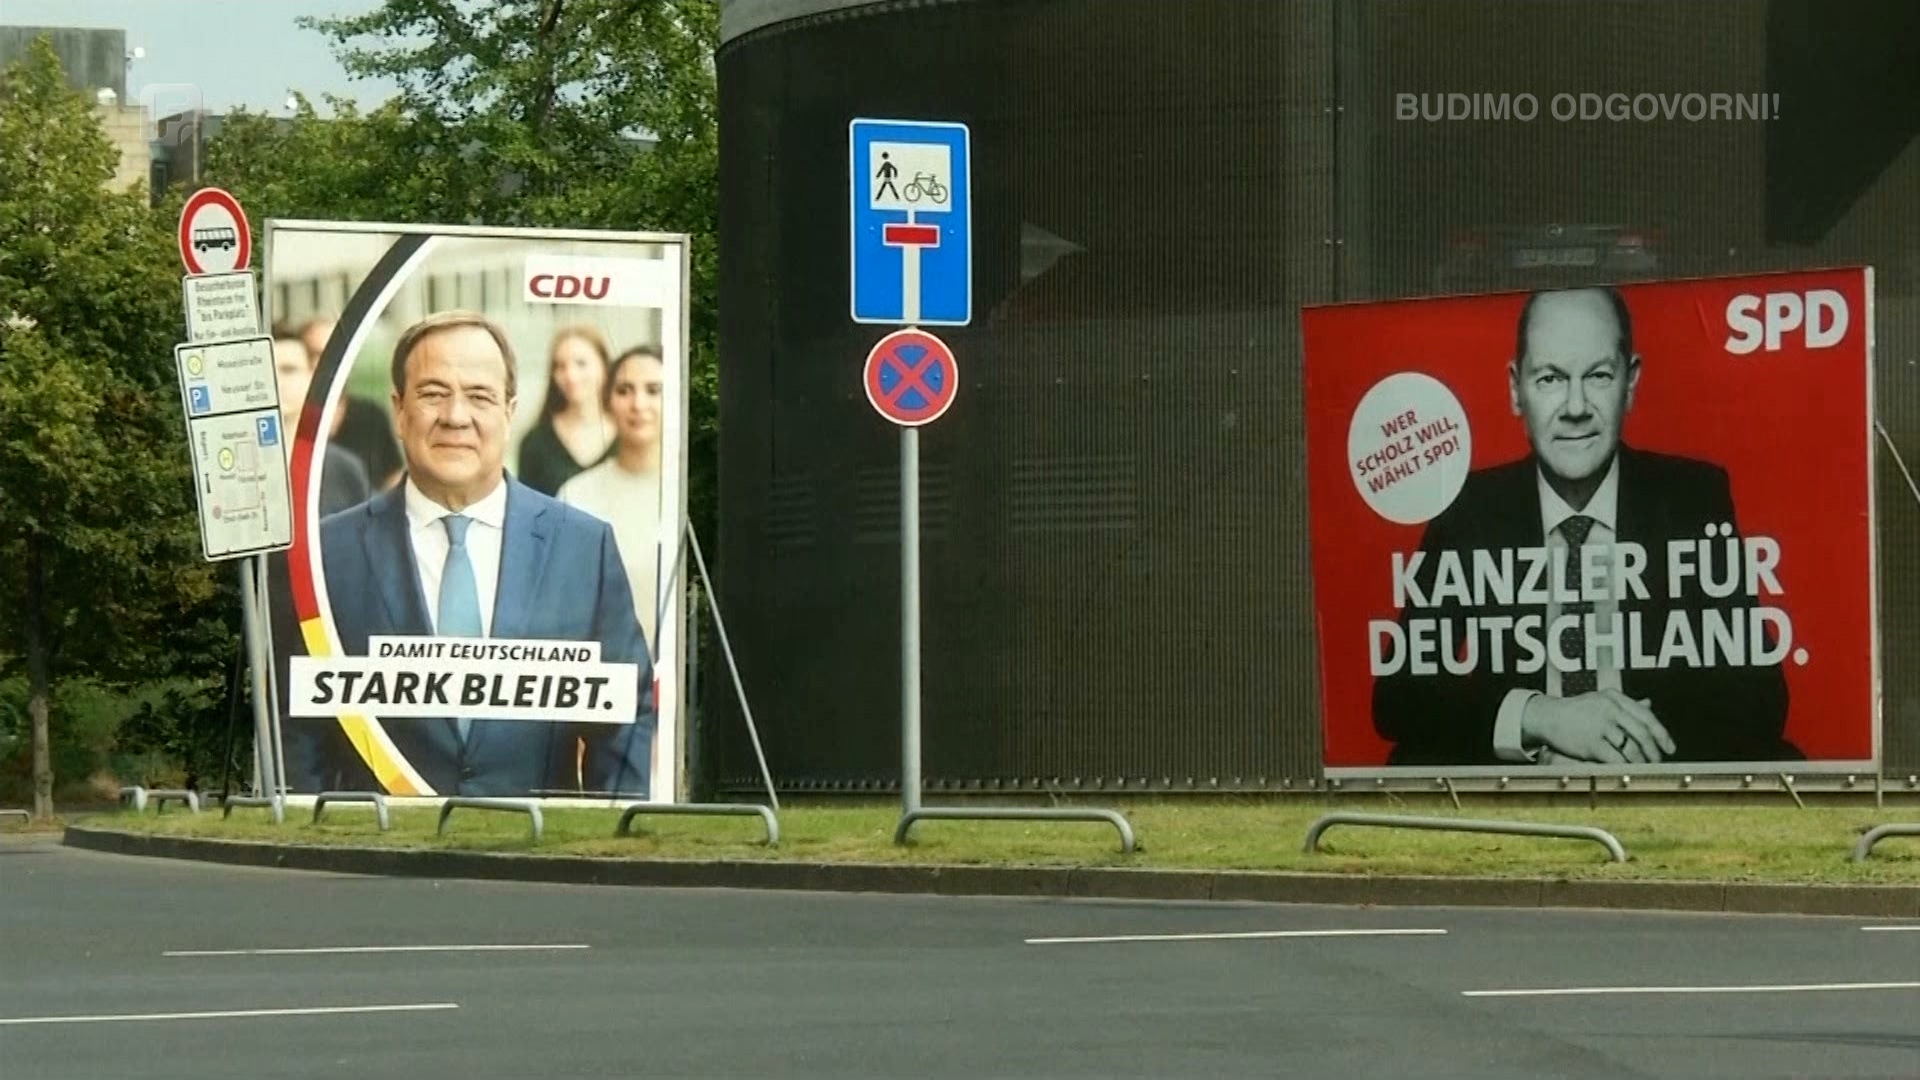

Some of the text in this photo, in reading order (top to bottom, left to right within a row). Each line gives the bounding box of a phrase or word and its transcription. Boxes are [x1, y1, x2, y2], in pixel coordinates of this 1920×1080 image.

[529, 274, 611, 300] CDU
[1724, 289, 1849, 355] SPD
[1356, 416, 1459, 476] SCHOLZ WILL,
[1380, 410, 1418, 438] WER
[1367, 435, 1460, 494] WÄHLT SPD!
[1391, 521, 1785, 609] KANZLER FÜR
[379, 643, 446, 659] DAMIT
[1368, 606, 1810, 677] DEUTSCHLAND.
[311, 671, 614, 711] STARK BLEIBT.
